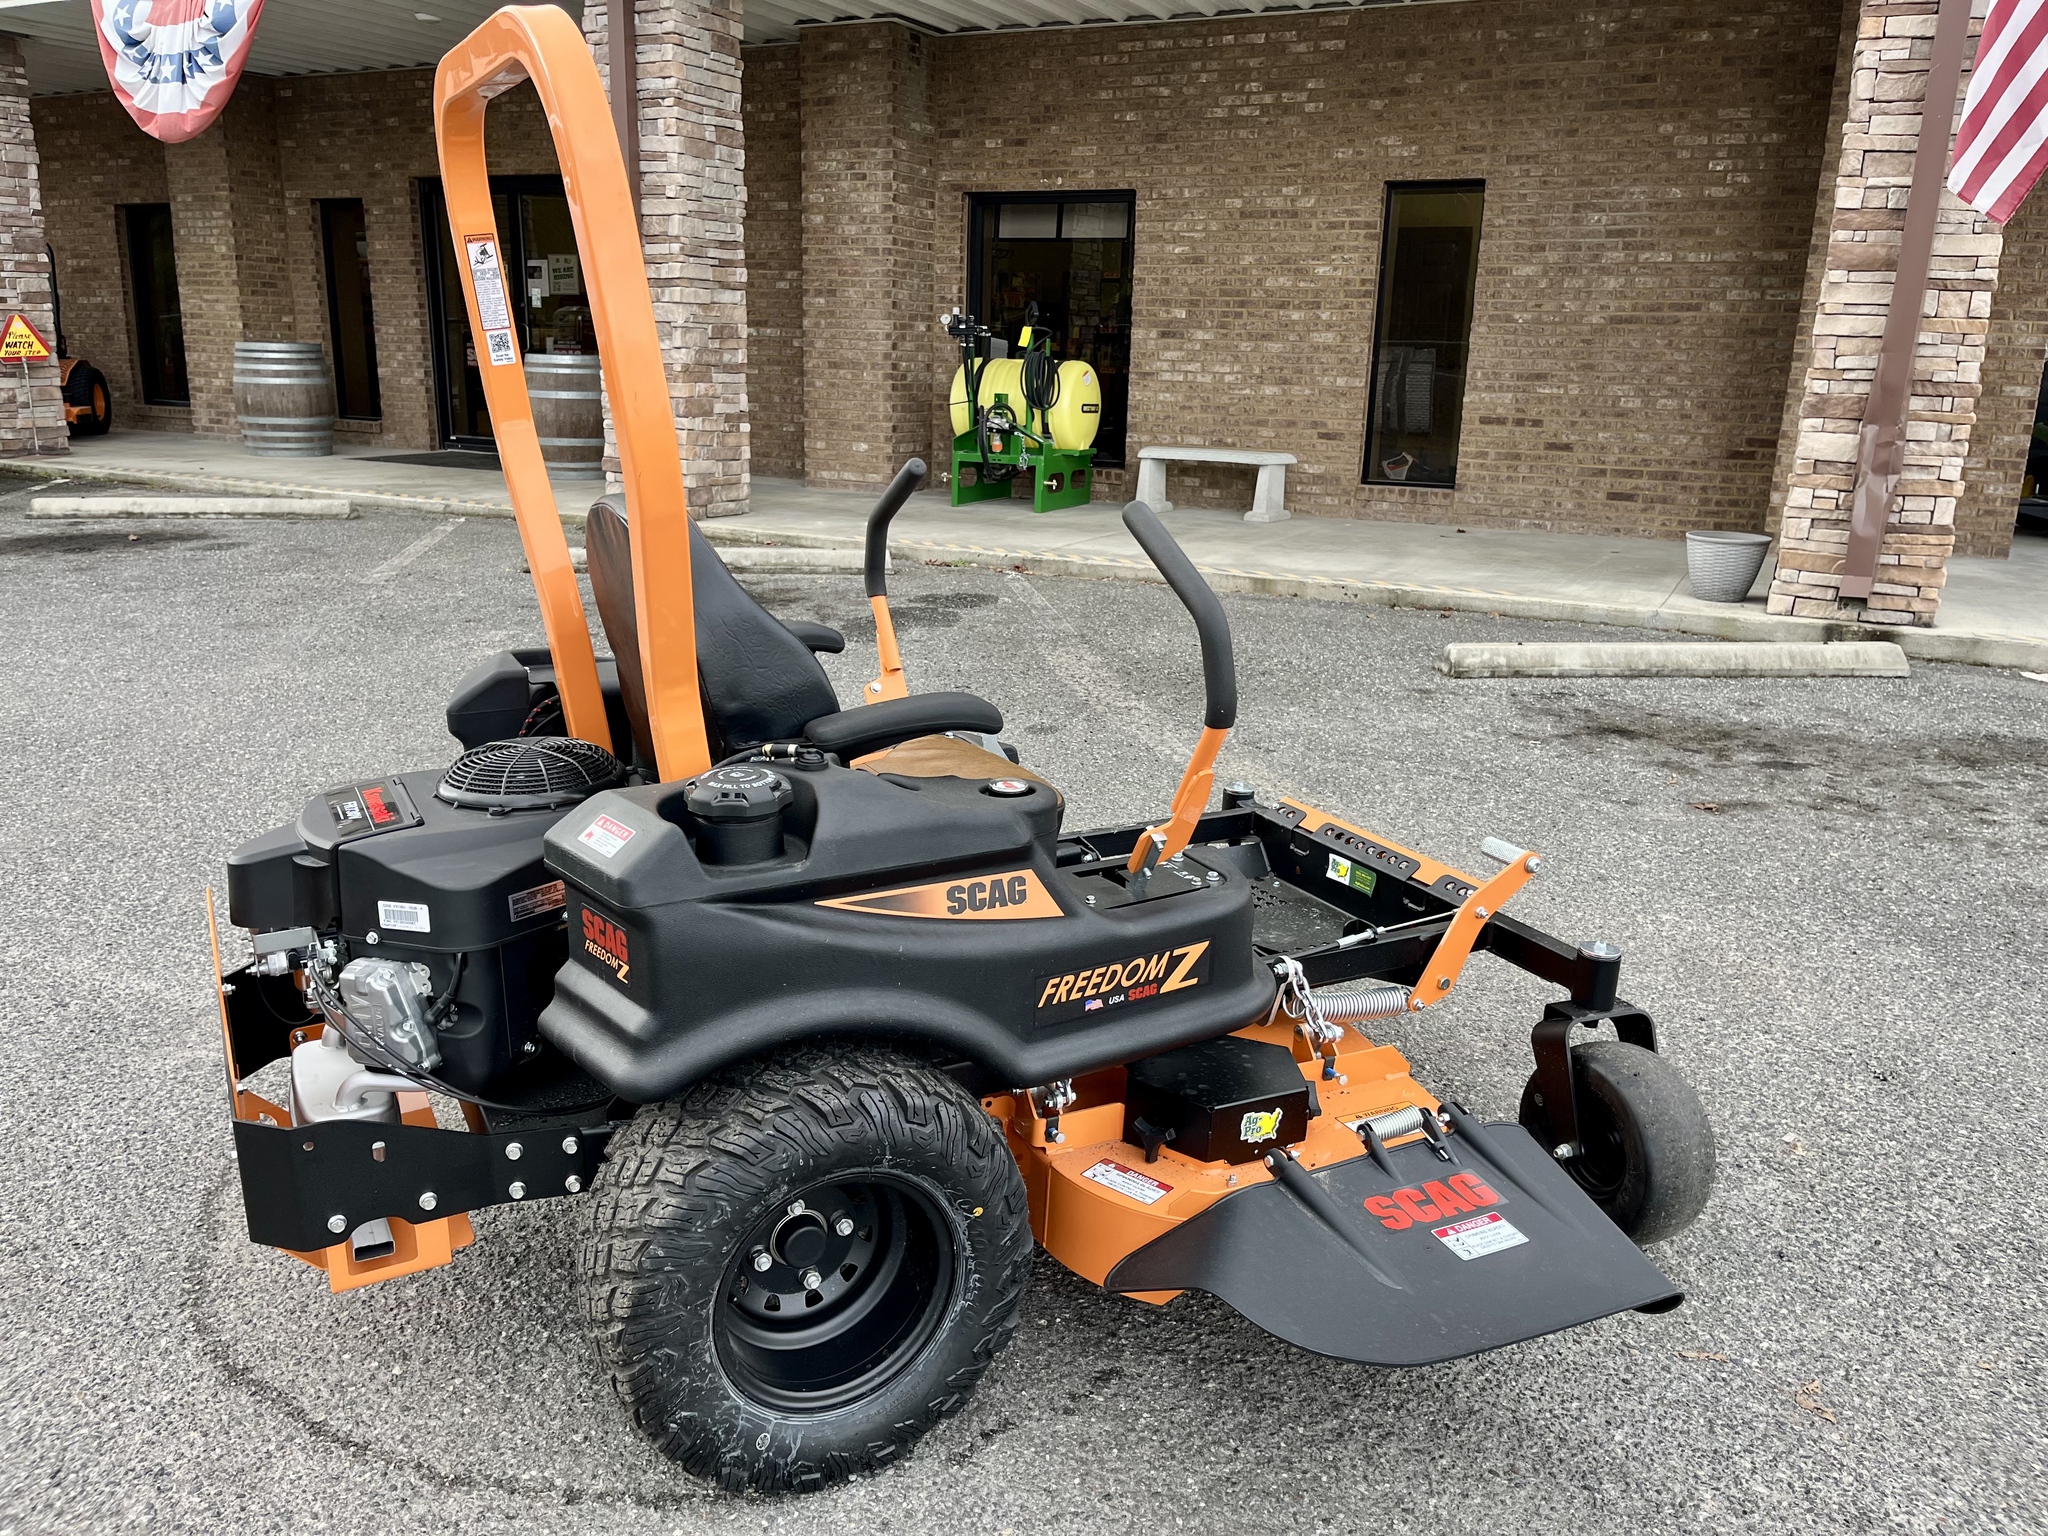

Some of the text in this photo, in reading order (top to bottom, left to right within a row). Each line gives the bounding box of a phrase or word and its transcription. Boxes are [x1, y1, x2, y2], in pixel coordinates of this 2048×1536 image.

[5, 341, 34, 349] WATCH
[707, 781, 722, 789] MAX
[362, 787, 396, 824] Kawasaki
[602, 821, 629, 839] DANGER
[946, 875, 1027, 915] SCAG
[582, 908, 628, 962] SCAG
[585, 939, 630, 984] FREEDOM Z
[1037, 940, 1210, 1008] FREEDOM Z
[1108, 983, 1158, 1005] USA SCAG
[1363, 1106, 1399, 1118] WARNING
[1244, 1116, 1263, 1127] Ag-
[1244, 1125, 1262, 1137] Pro
[1126, 1170, 1159, 1187] DANGER
[1364, 1173, 1499, 1230] SCAG
[1454, 1217, 1492, 1232] DANGER
[1488, 1224, 1505, 1233] BLADES
[885, 1391, 919, 1418] TUBELESS
